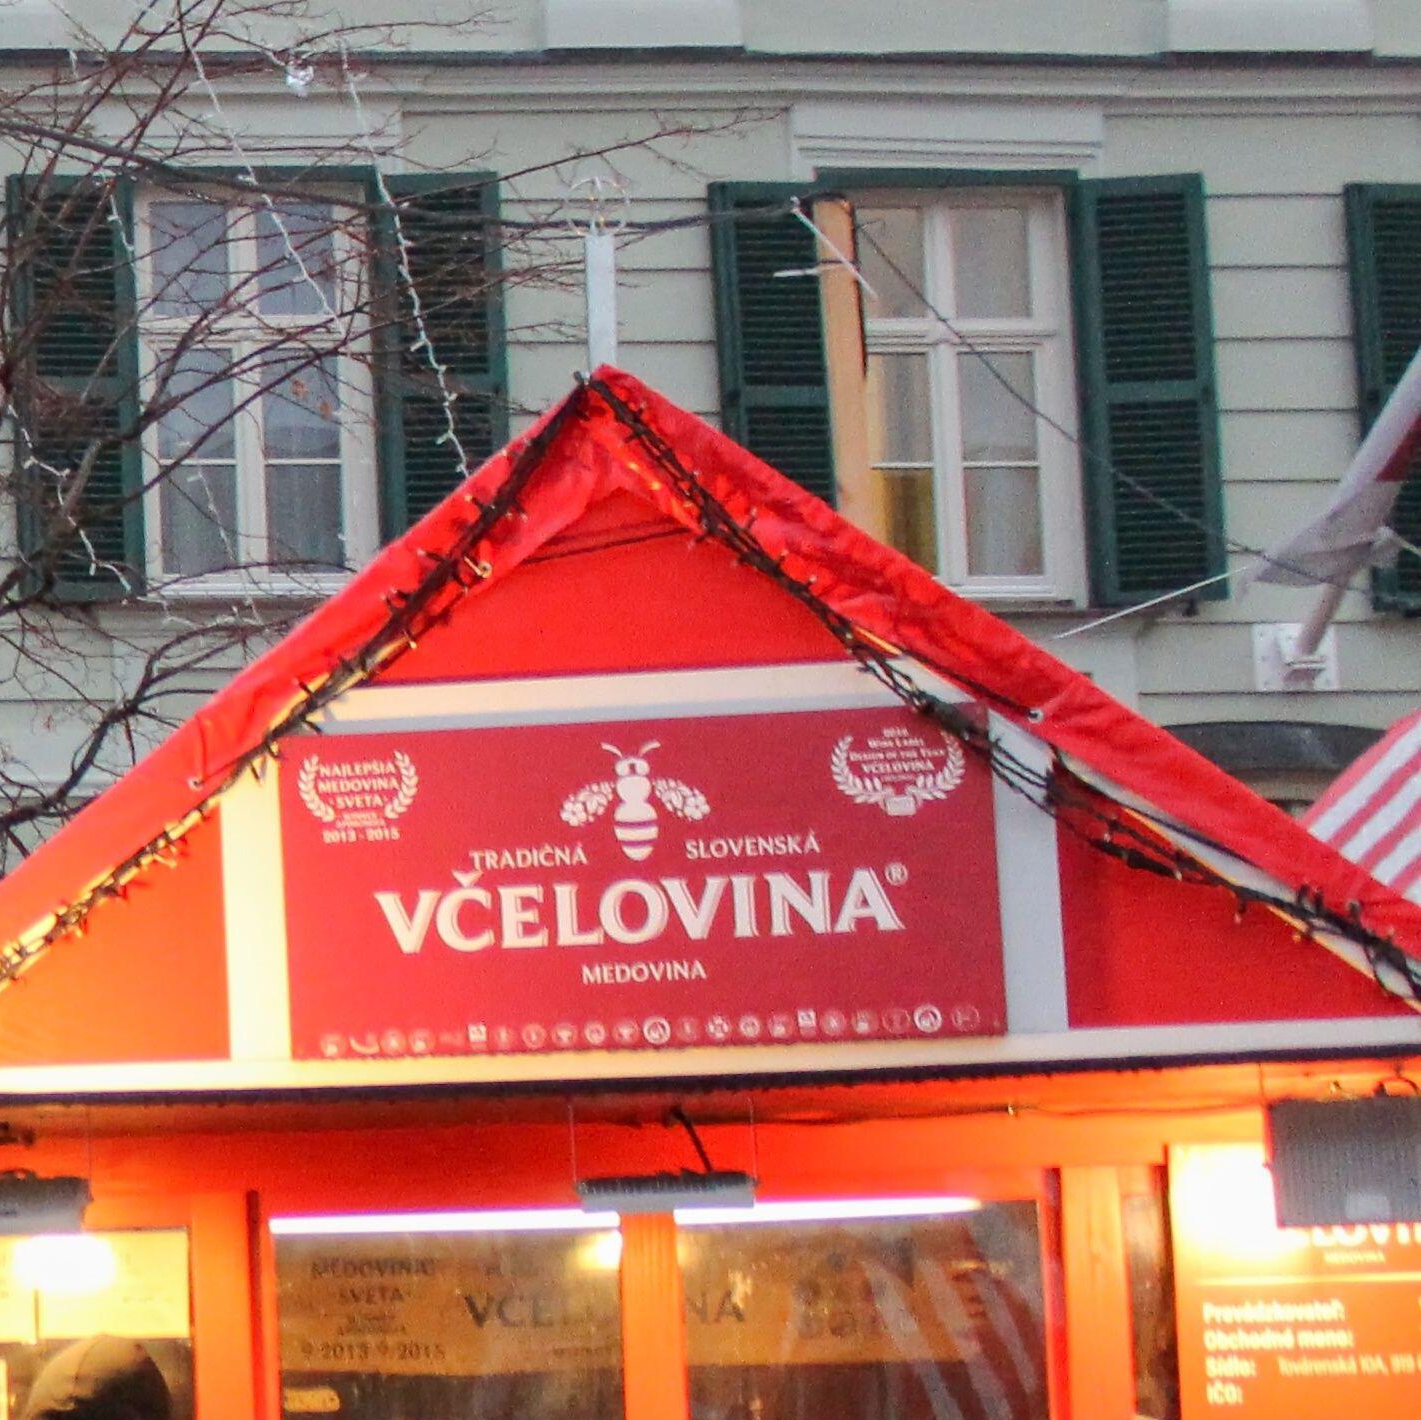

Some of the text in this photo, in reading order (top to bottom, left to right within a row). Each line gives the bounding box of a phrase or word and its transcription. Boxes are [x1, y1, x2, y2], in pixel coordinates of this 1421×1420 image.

[316, 776, 400, 793] MEDOVINA
[335, 793, 384, 809] SVETA
[470, 830, 821, 870] TRADIČNÁ SLOVENSKÁ
[582, 960, 707, 985] MEDOVINA
